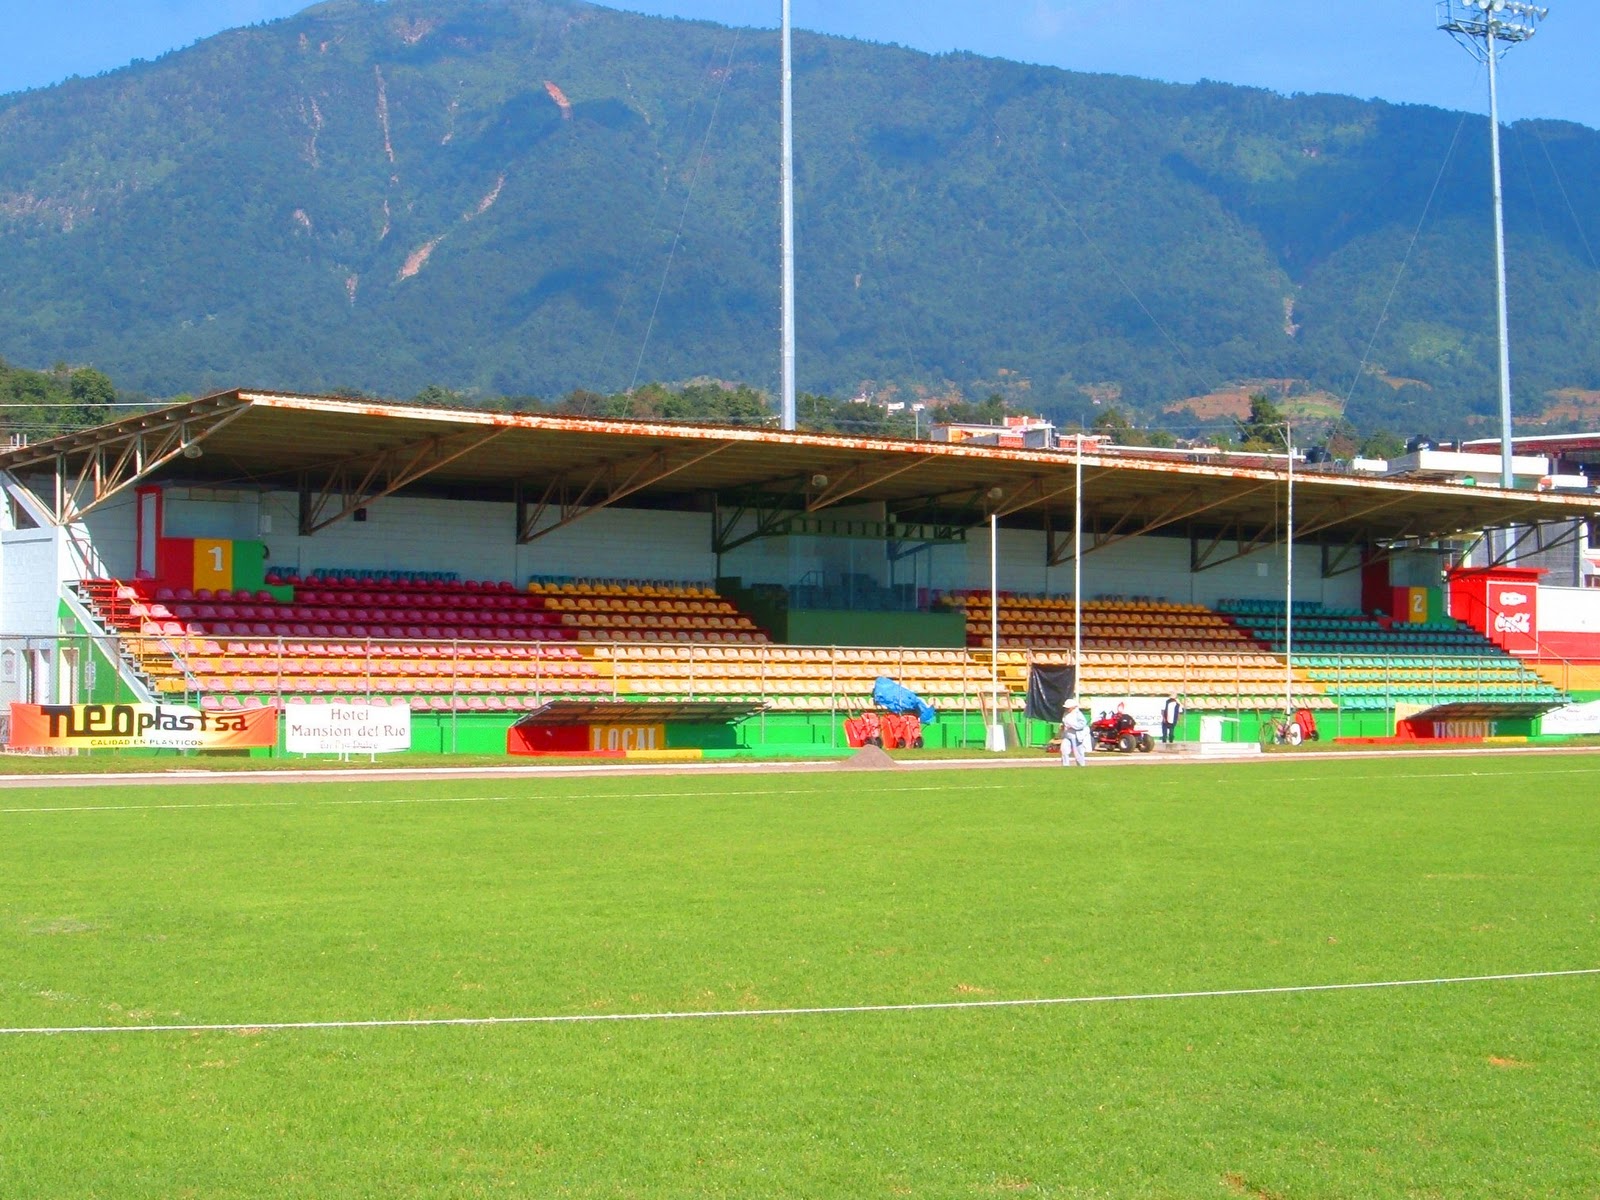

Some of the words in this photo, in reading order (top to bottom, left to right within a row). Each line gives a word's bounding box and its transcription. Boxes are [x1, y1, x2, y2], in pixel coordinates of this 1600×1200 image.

[208, 546, 223, 571] 1
[1413, 594, 1422, 612] 2
[331, 708, 369, 721] Hotel
[357, 725, 379, 737] del
[592, 727, 659, 752] LOCAL
